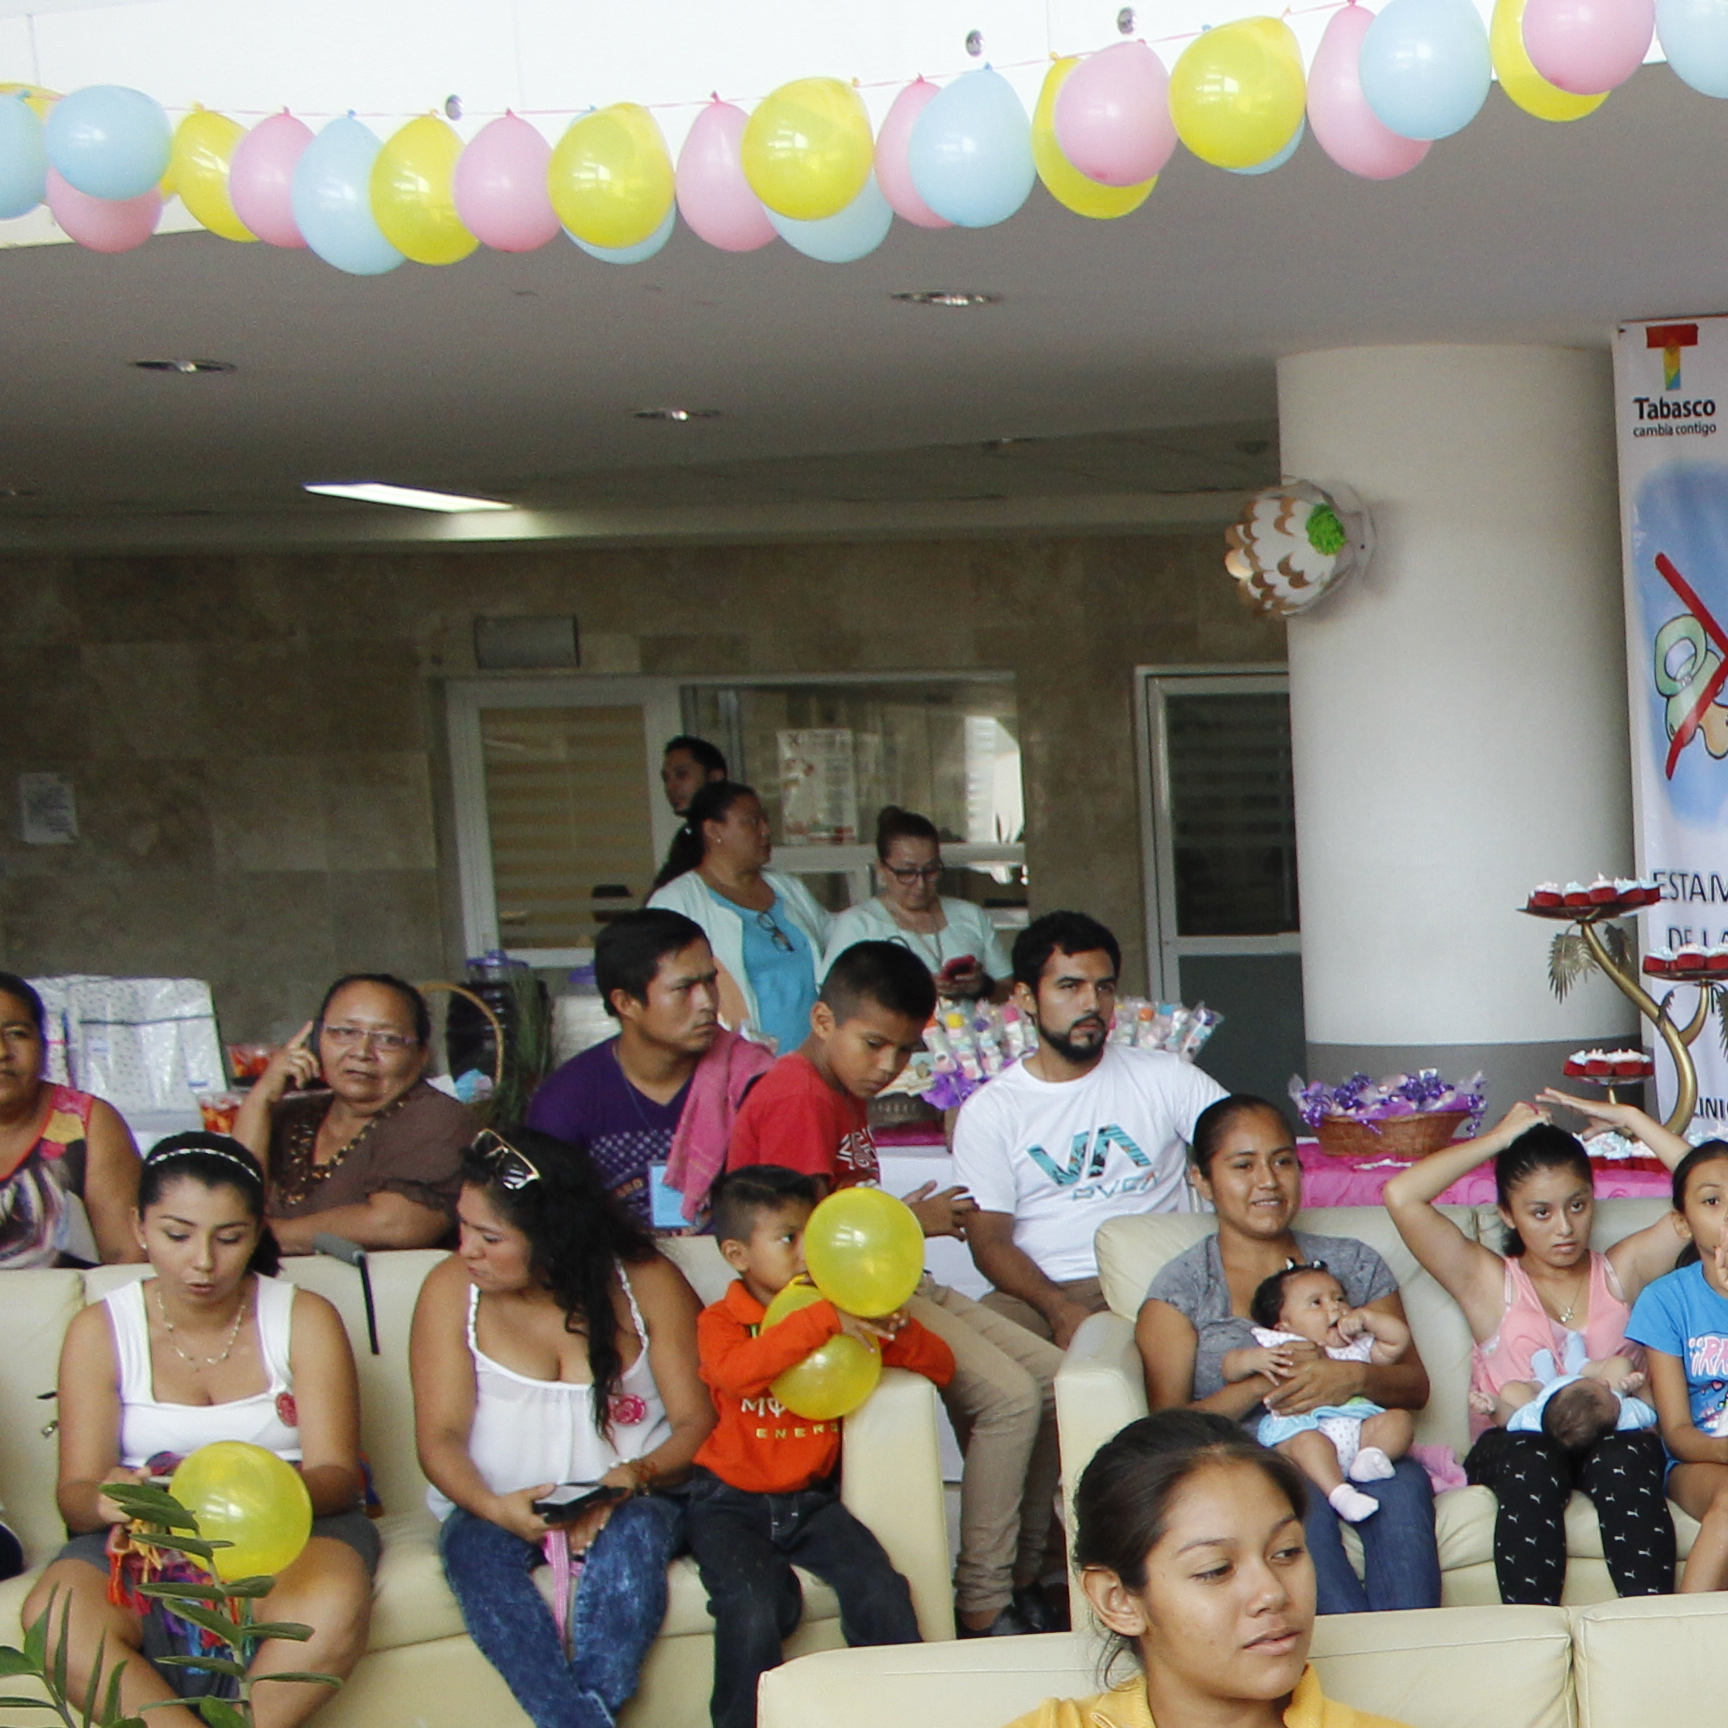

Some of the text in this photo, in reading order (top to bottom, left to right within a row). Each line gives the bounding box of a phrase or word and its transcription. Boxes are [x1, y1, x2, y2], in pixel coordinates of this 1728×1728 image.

[1633, 397, 1716, 420] Tabasco
[1633, 422, 1717, 437] cambia contigo
[755, 1422, 838, 1438] ENERG
